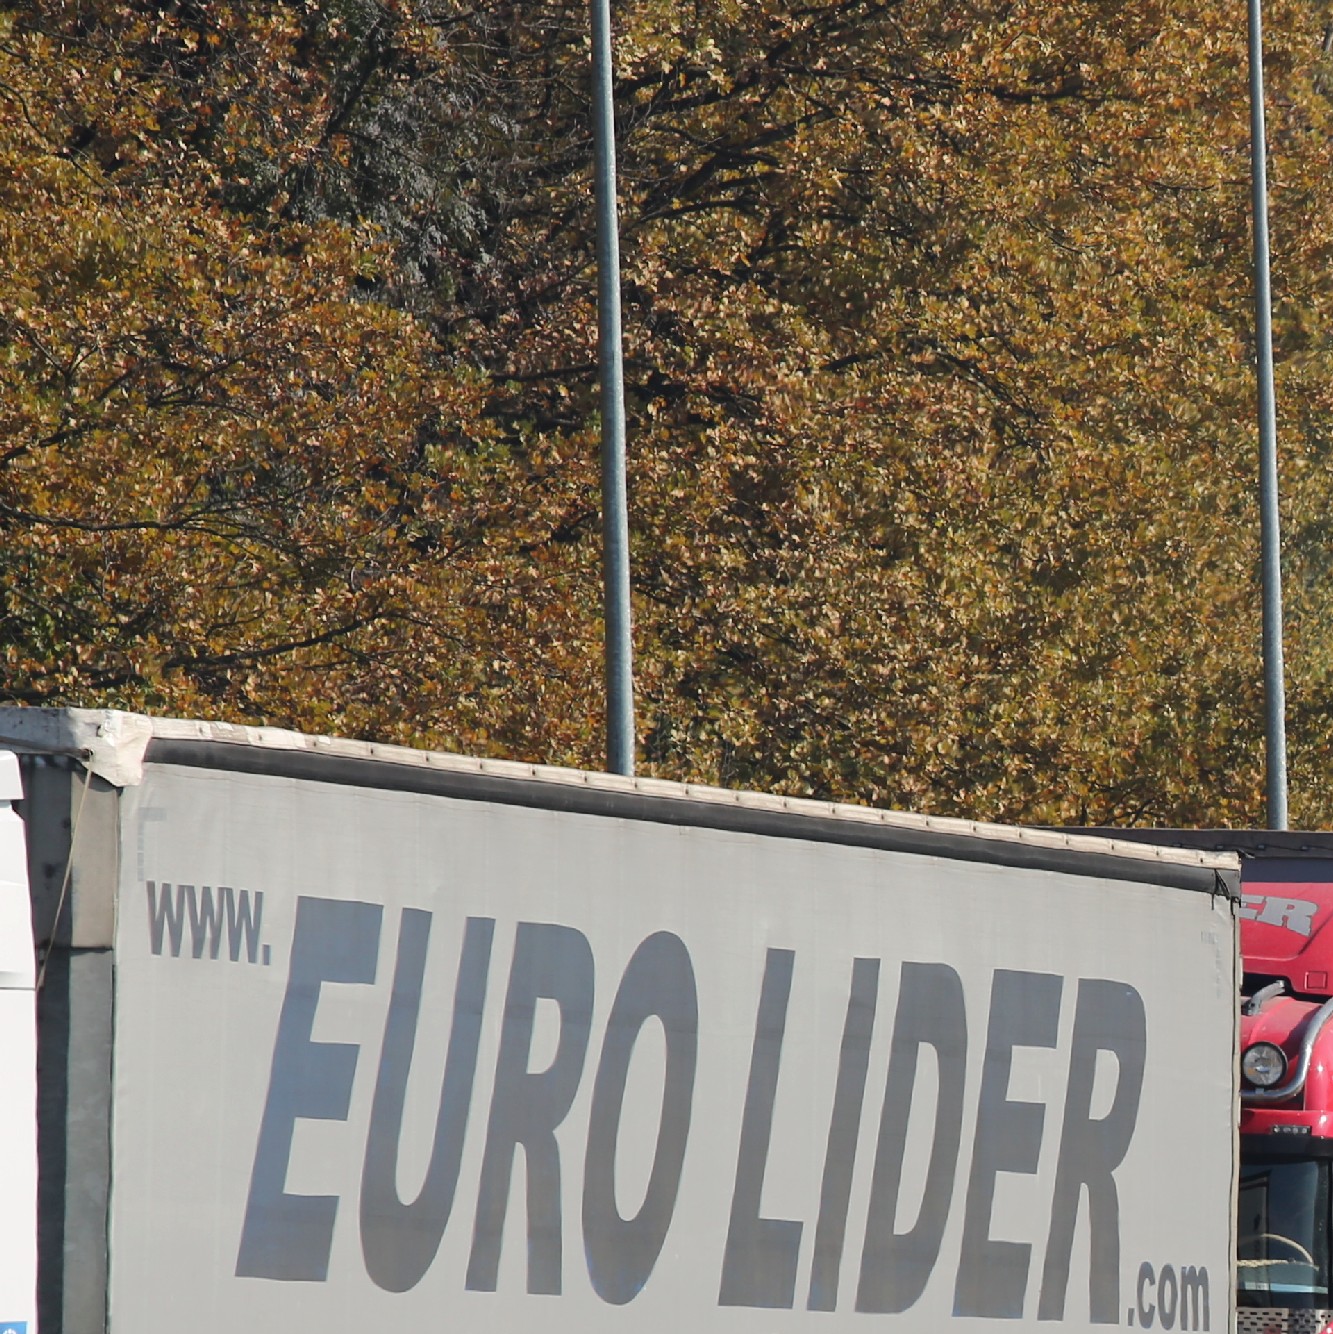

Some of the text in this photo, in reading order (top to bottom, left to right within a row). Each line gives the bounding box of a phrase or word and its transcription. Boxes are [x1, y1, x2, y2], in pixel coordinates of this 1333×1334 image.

[146, 880, 1211, 1332] www. EURO LIDER .com
